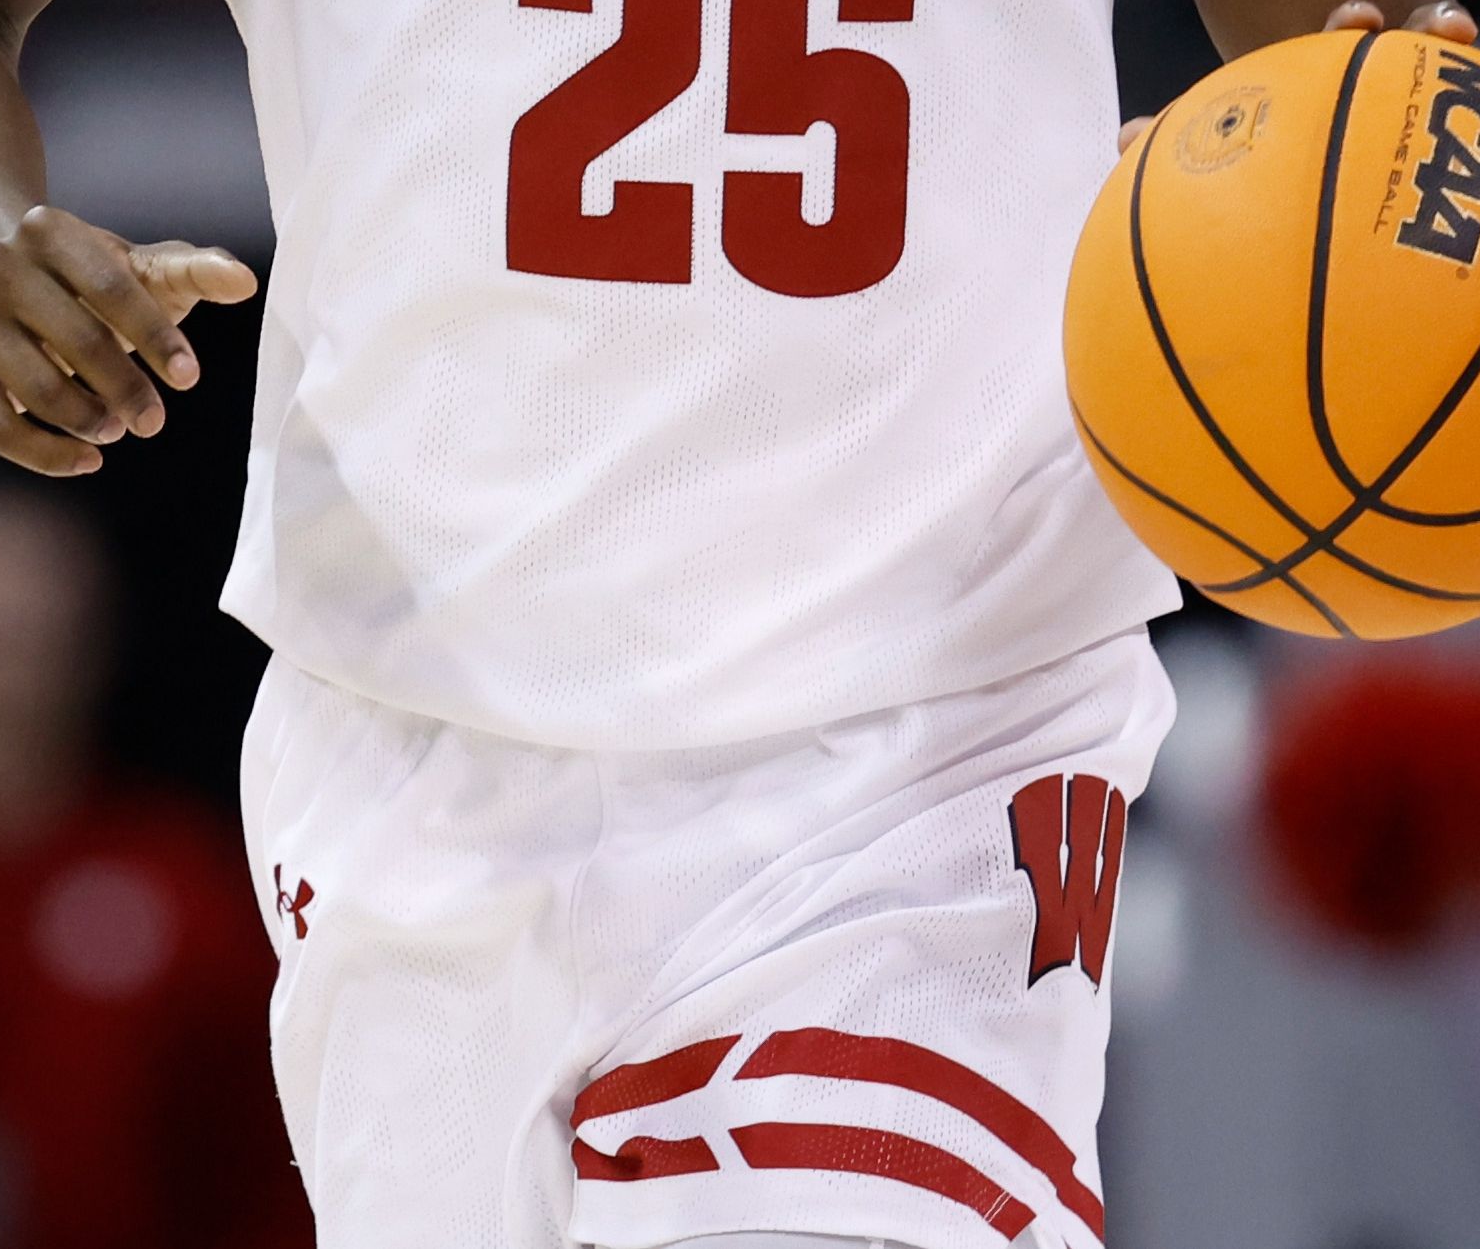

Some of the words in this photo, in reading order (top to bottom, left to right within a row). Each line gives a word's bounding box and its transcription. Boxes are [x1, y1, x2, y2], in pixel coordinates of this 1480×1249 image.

[1394, 104, 1420, 165] GAME
[1372, 169, 1403, 235] BALL
[1007, 772, 1126, 991] W
